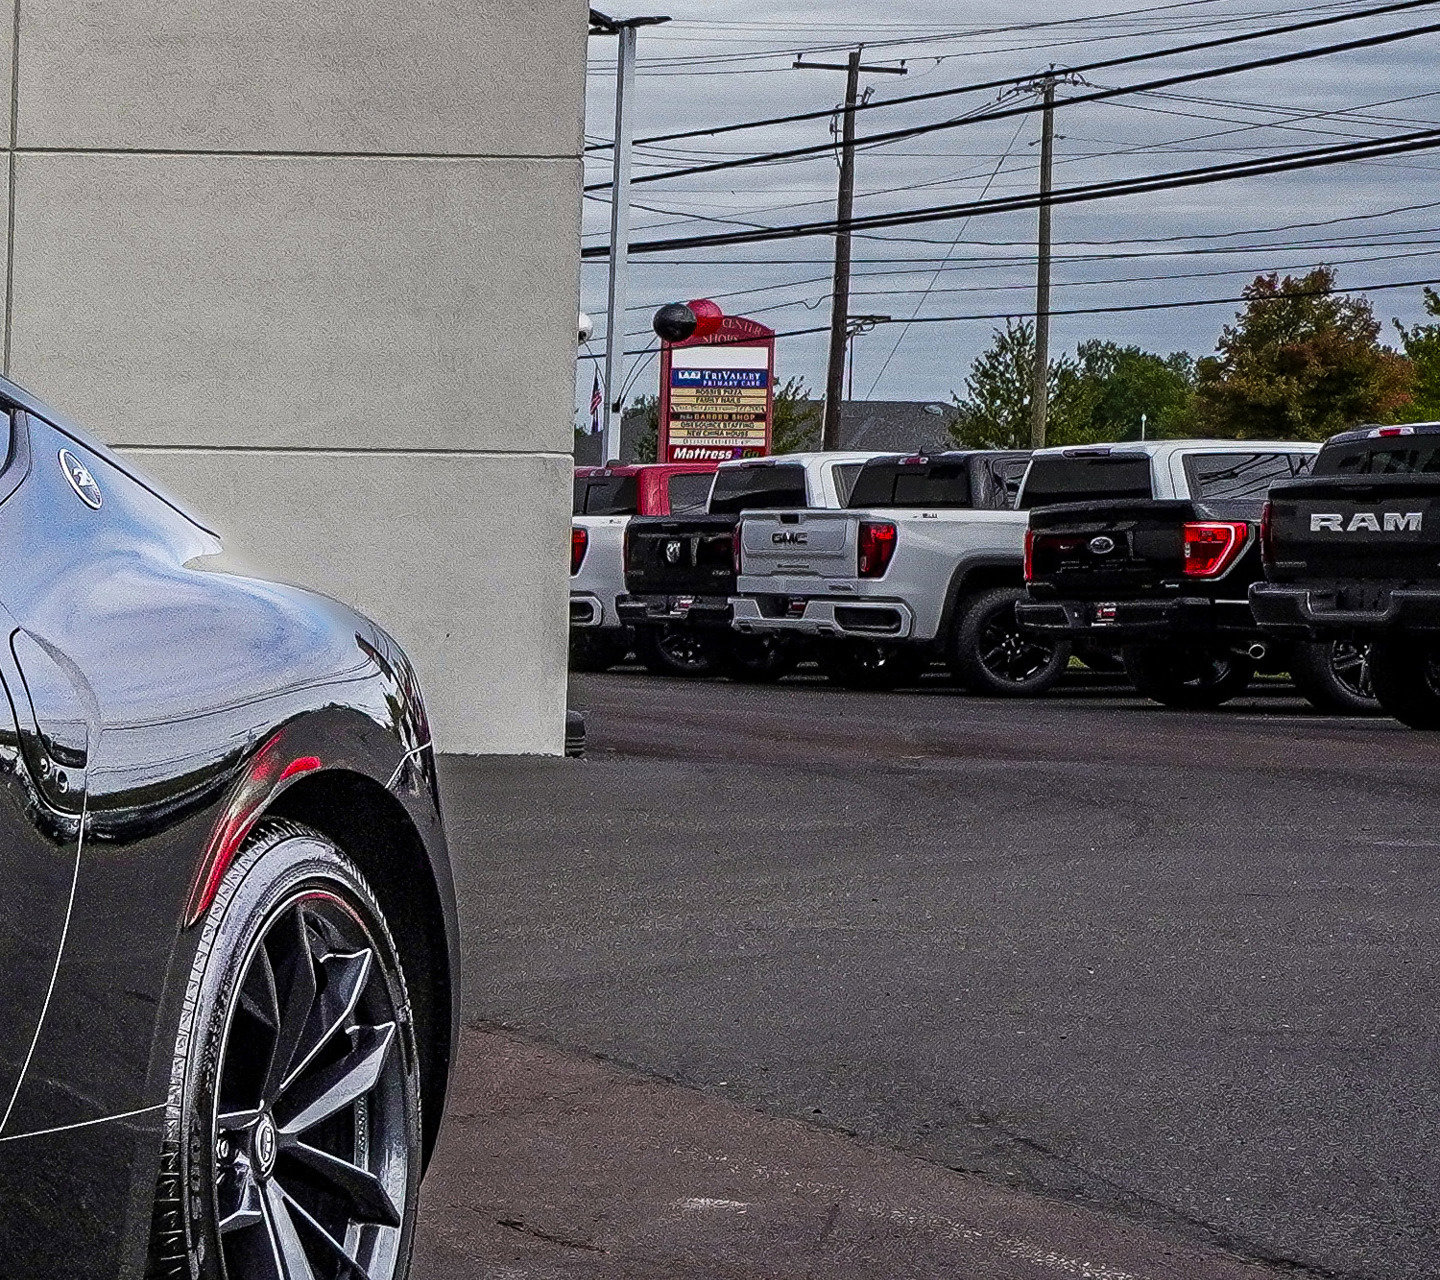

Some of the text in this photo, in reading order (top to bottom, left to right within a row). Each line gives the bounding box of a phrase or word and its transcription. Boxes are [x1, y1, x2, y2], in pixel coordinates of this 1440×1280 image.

[673, 447, 733, 460] Mattress
[1309, 511, 1424, 532] RAM
[771, 531, 809, 546] GMC
